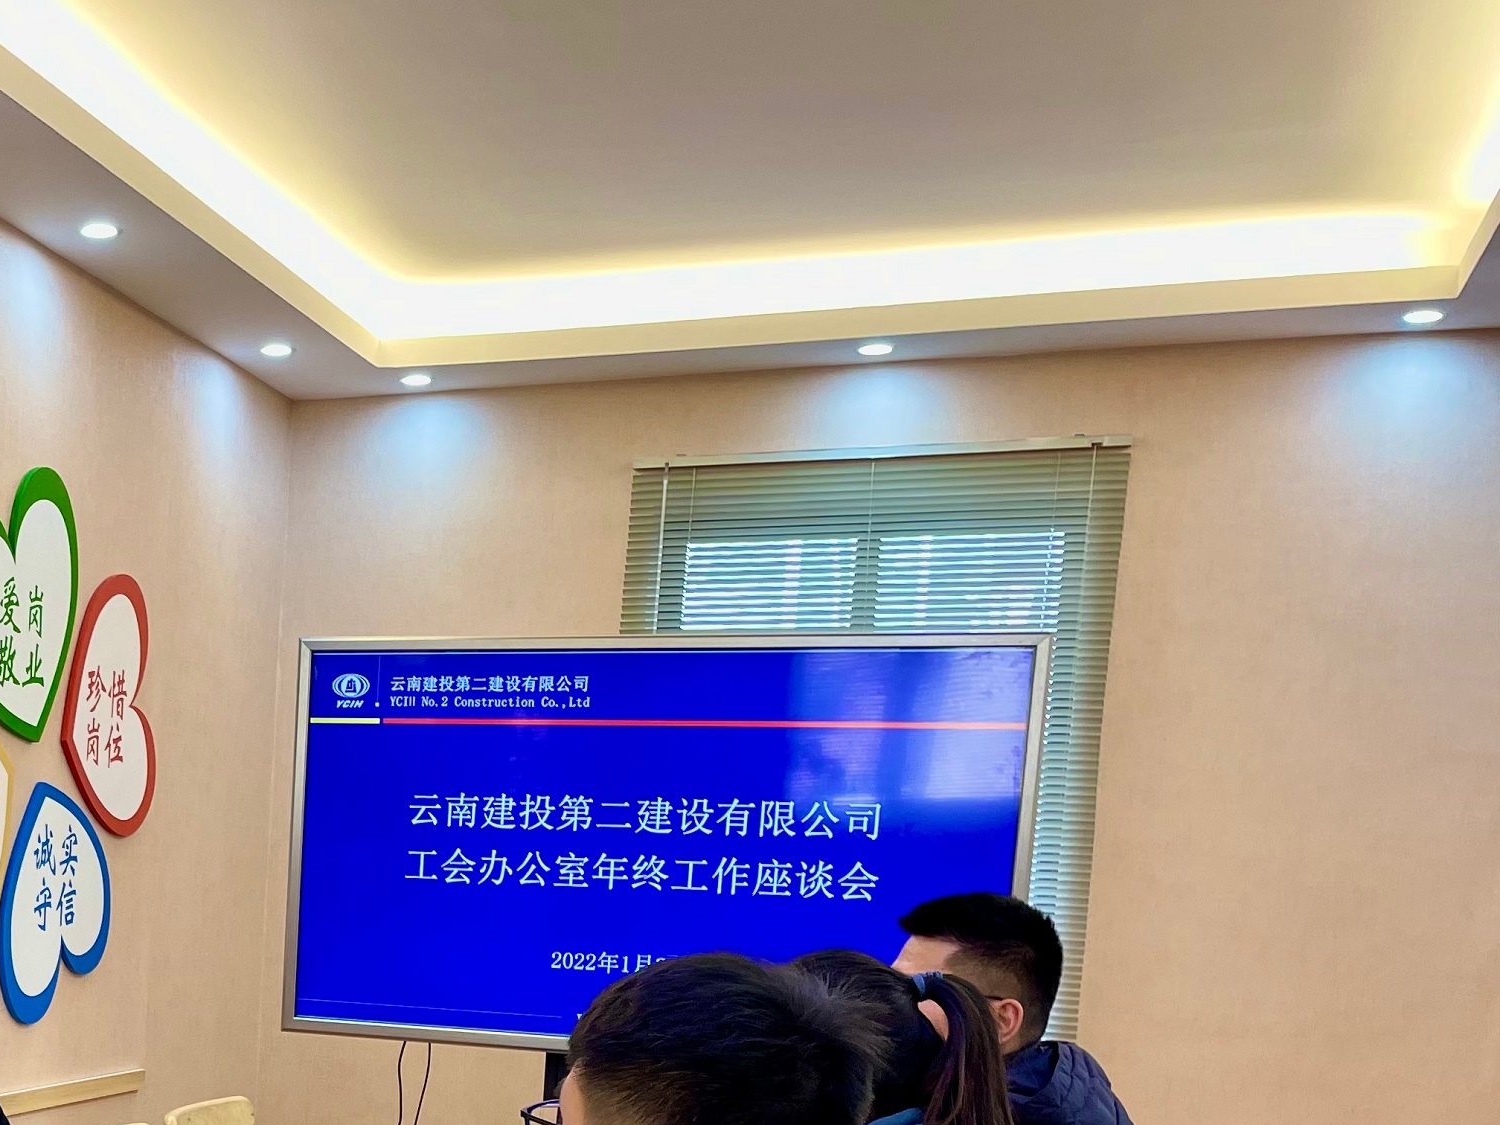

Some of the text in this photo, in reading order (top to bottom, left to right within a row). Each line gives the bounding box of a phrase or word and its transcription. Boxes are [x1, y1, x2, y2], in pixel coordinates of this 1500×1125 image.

[86, 665, 128, 720] 珍惜
[390, 675, 589, 692] 云南建投第二建设有限公司
[454, 696, 535, 708] Construction
[541, 696, 591, 709] Co.,Ltd
[86, 718, 124, 768] 岗位
[408, 792, 882, 841] 云南建投第二建设有限公司
[33, 823, 78, 877] 诚实
[404, 847, 880, 902] 工会办公室年终工作座谈会
[33, 878, 77, 932] 守信
[551, 951, 678, 975] 2022年1月
